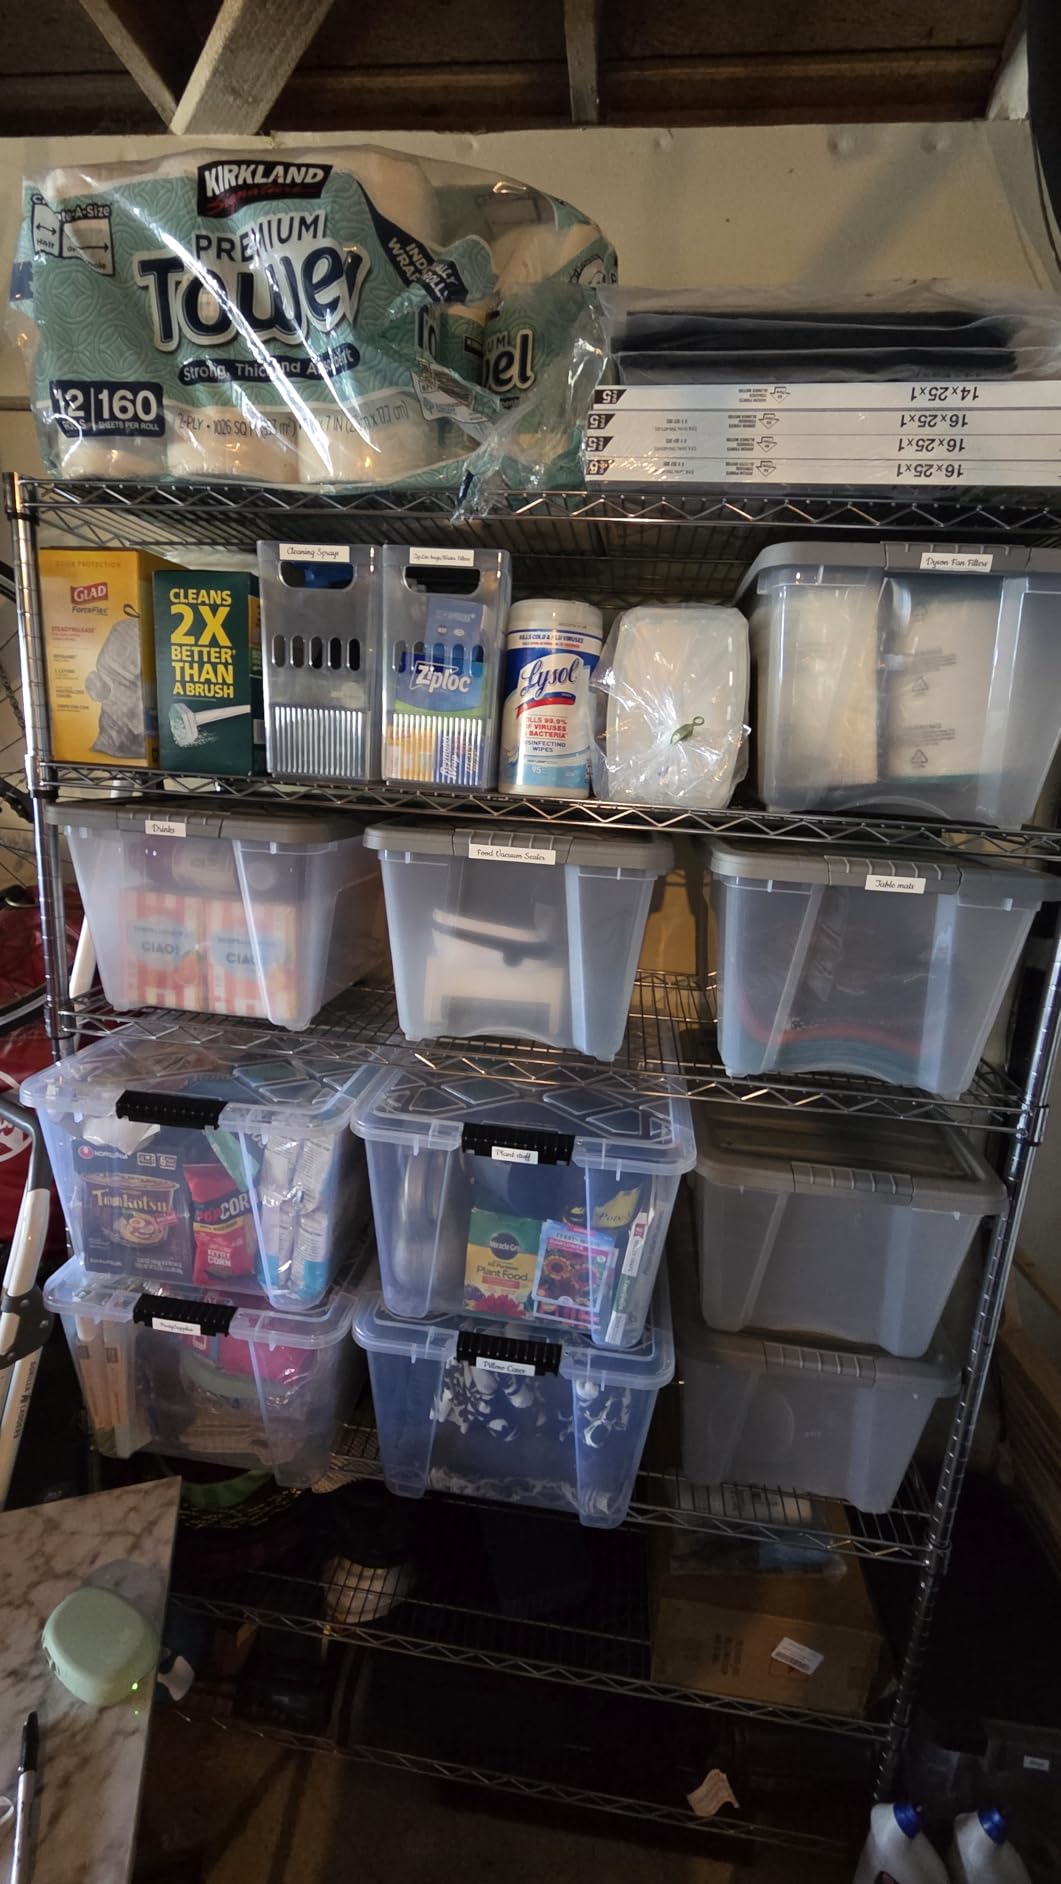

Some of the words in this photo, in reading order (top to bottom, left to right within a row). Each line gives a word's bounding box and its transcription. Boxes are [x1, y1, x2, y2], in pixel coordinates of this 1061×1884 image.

[204, 164, 325, 198] KIRKLAND
[195, 213, 327, 263] PREMIUM
[138, 246, 364, 344] Towel
[183, 363, 230, 382] Strong,
[235, 362, 275, 378] Thic
[602, 390, 611, 403] 5
[910, 386, 979, 402] 14x25x1
[53, 388, 86, 418] 12
[98, 388, 158, 422] 160
[125, 421, 140, 430] PER
[141, 422, 160, 431] ROLL
[590, 415, 599, 428] 5
[900, 414, 968, 428] 16x25x1
[588, 437, 598, 450] 5
[898, 438, 966, 452] 16x25x1
[896, 464, 964, 478] 16x25x1
[925, 556, 948, 568] Dyson
[951, 557, 965, 567] Fan
[967, 557, 988, 567] Filters
[73, 584, 107, 602] GLAD
[169, 588, 232, 605] CLEANS
[170, 604, 232, 647] 2X
[171, 661, 234, 684] THAN
[415, 664, 471, 693] Ziploc
[520, 657, 580, 698] Lysol
[173, 682, 184, 695] A
[185, 682, 234, 698] BRUSH
[534, 723, 567, 732] VIRUSES
[543, 717, 568, 725] 99.9%
[152, 823, 175, 834] Drinks
[477, 848, 494, 857] Food
[495, 849, 523, 859] Vacuum
[875, 879, 896, 889] Table
[897, 882, 914, 890] mats
[141, 942, 181, 956] CIAO!
[92, 1188, 168, 1213] Tonkotsu
[196, 1192, 251, 1222] POPCOR
[207, 1255, 232, 1268] CORN
[476, 1264, 501, 1278] Plant
[502, 1270, 528, 1281] Food
